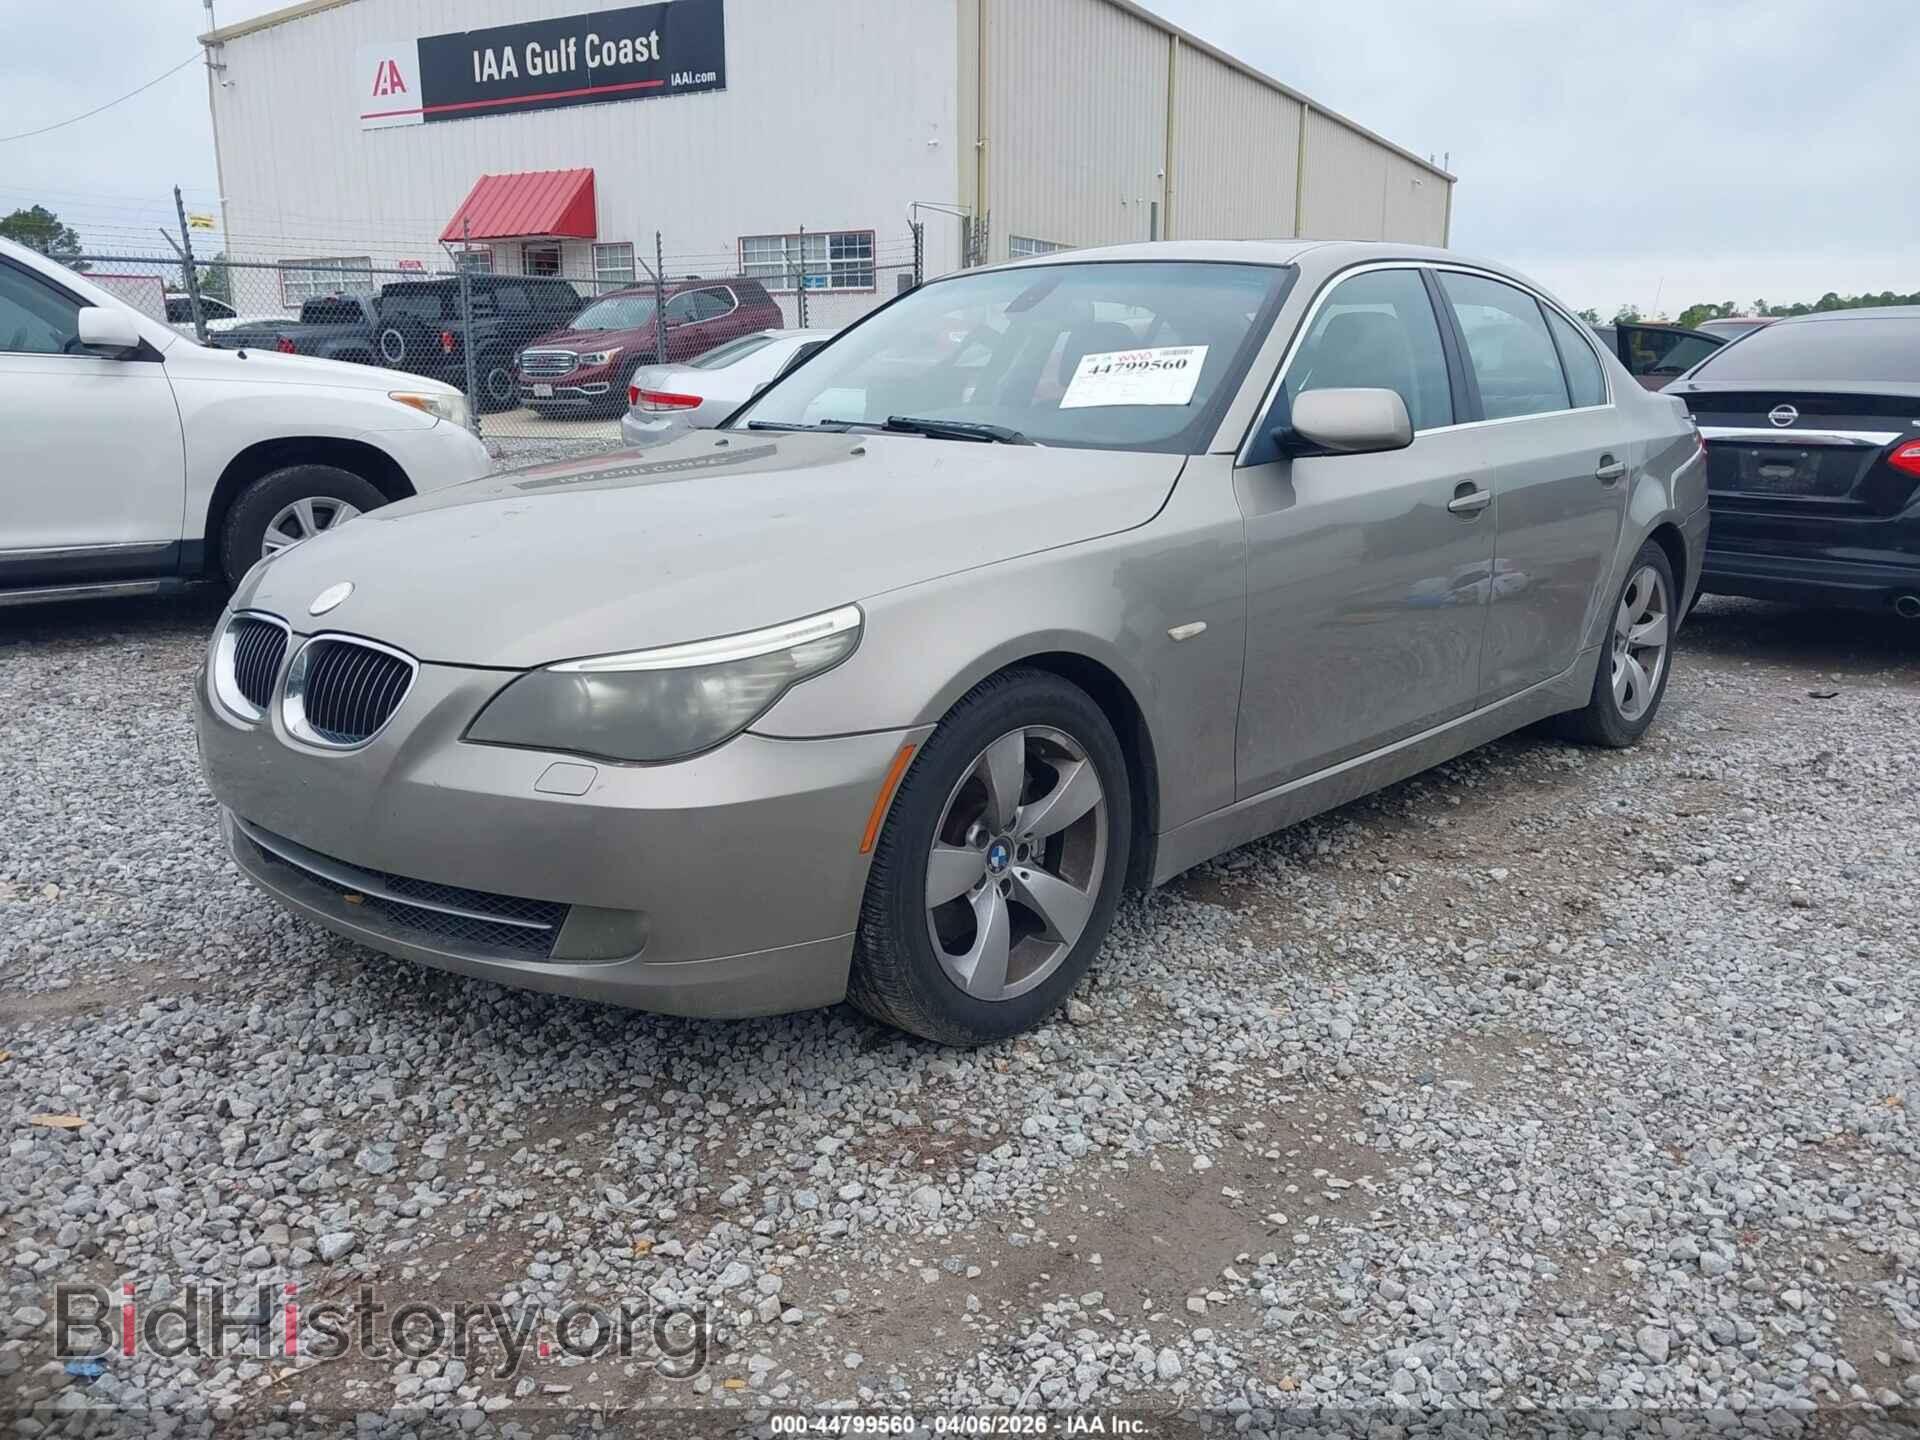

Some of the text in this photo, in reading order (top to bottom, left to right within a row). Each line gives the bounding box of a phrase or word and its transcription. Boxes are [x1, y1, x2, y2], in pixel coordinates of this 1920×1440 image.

[473, 29, 660, 83] IAA Gulf Coast
